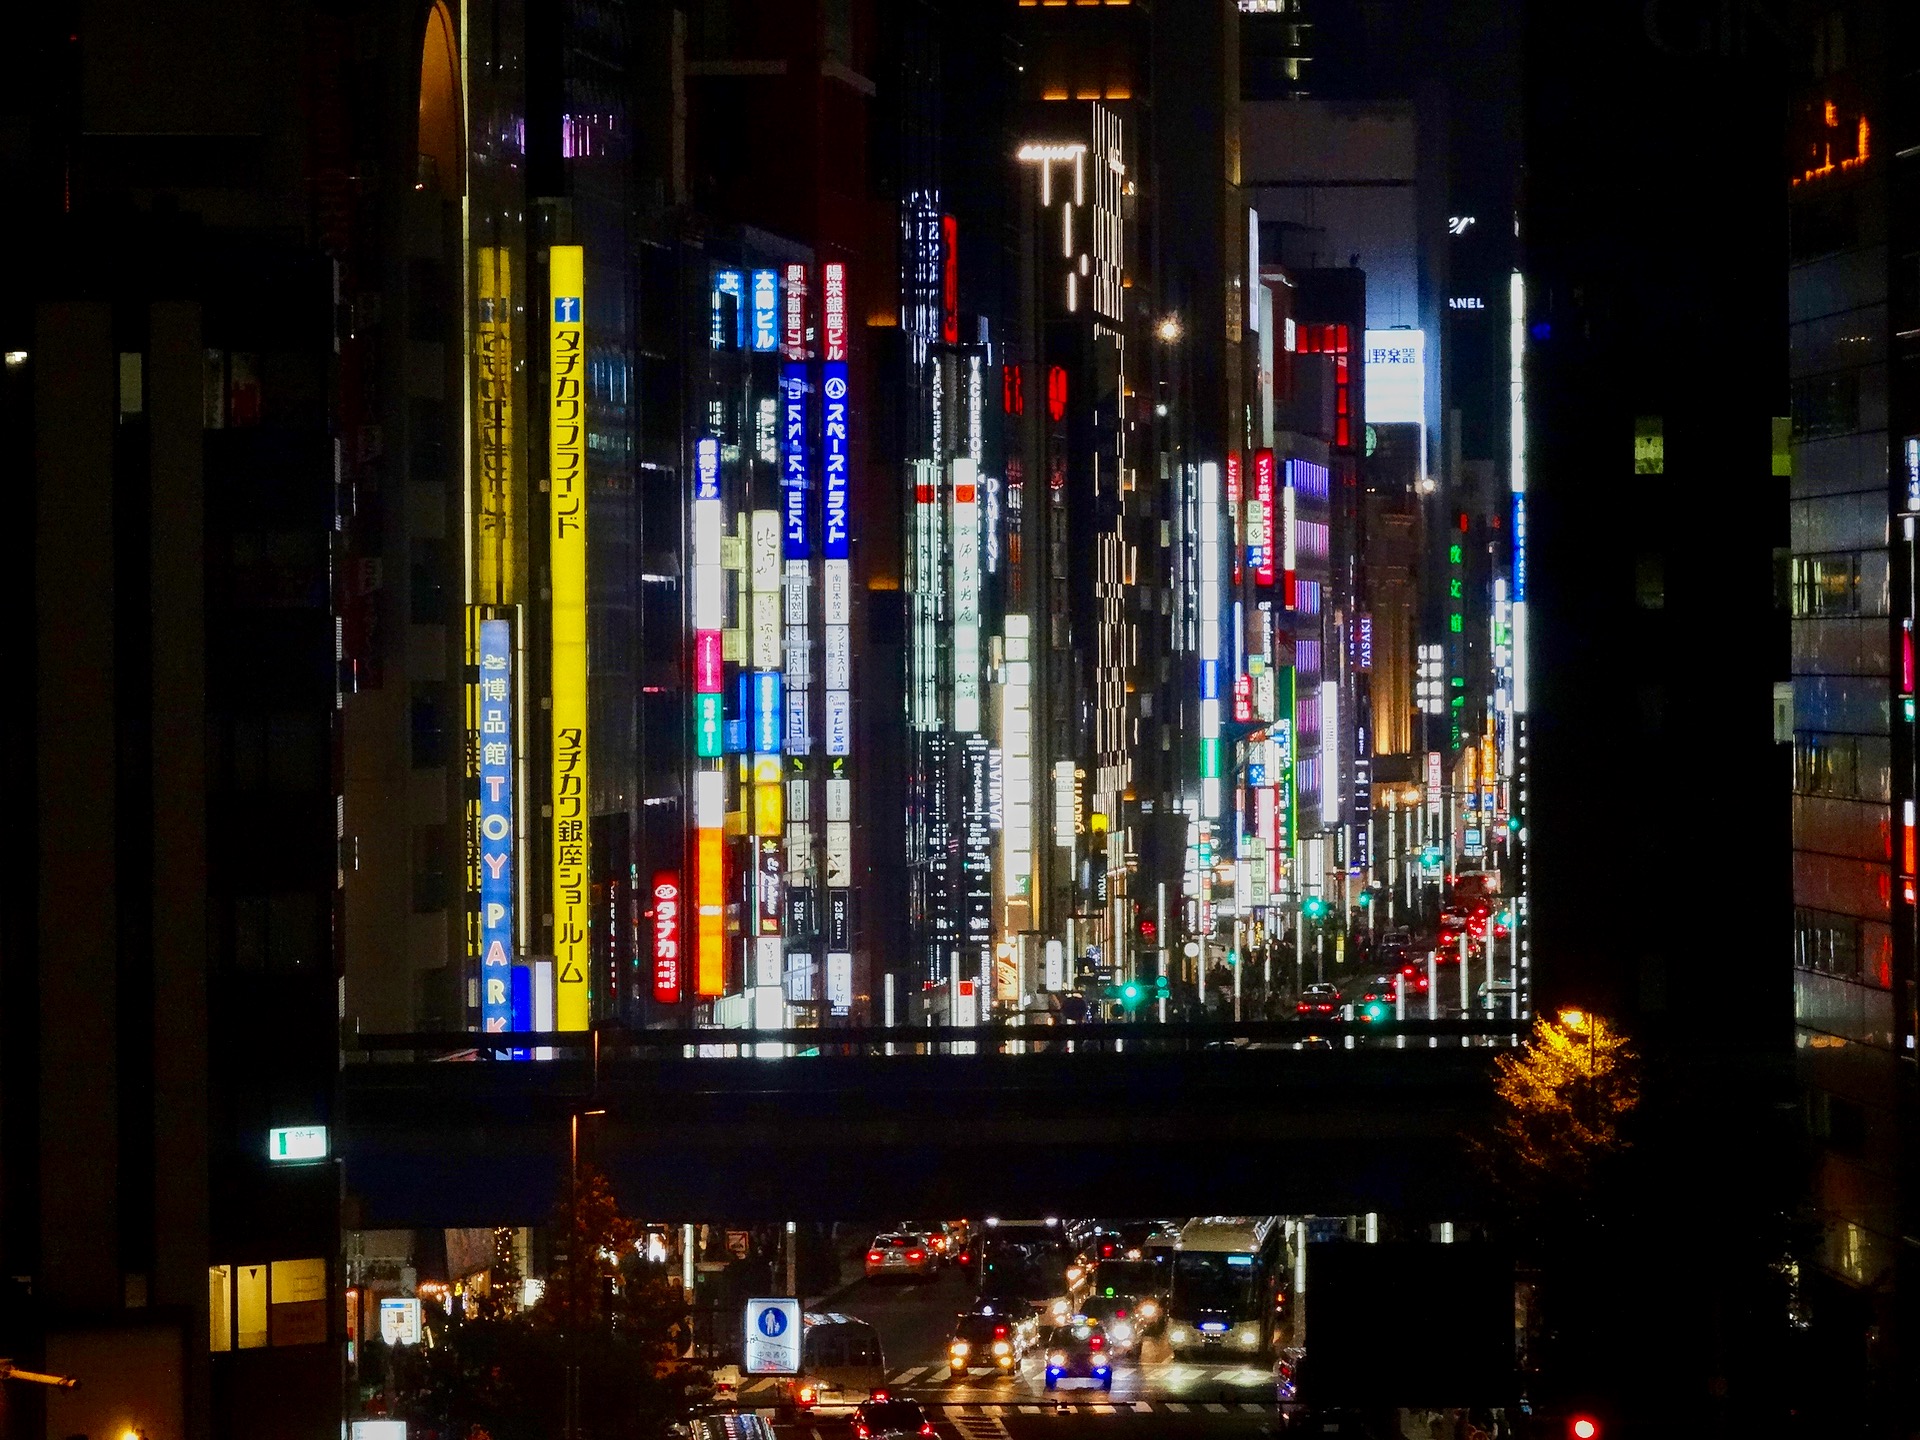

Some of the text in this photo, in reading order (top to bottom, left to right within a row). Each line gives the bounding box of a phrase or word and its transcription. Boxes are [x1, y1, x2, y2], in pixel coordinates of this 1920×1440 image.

[826, 264, 844, 361] 陽栄銀座ビル
[554, 330, 581, 541] タチカワブラインド
[760, 399, 776, 463] BALLY
[970, 356, 981, 464] VACHERON
[826, 403, 846, 544] スペーストラスト
[1361, 617, 1372, 668] TASAKI
[482, 677, 508, 765] 博品館
[482, 776, 509, 880] TOY
[557, 727, 584, 984] タチカワ銀座ショールーム
[656, 901, 677, 958] タナカ
